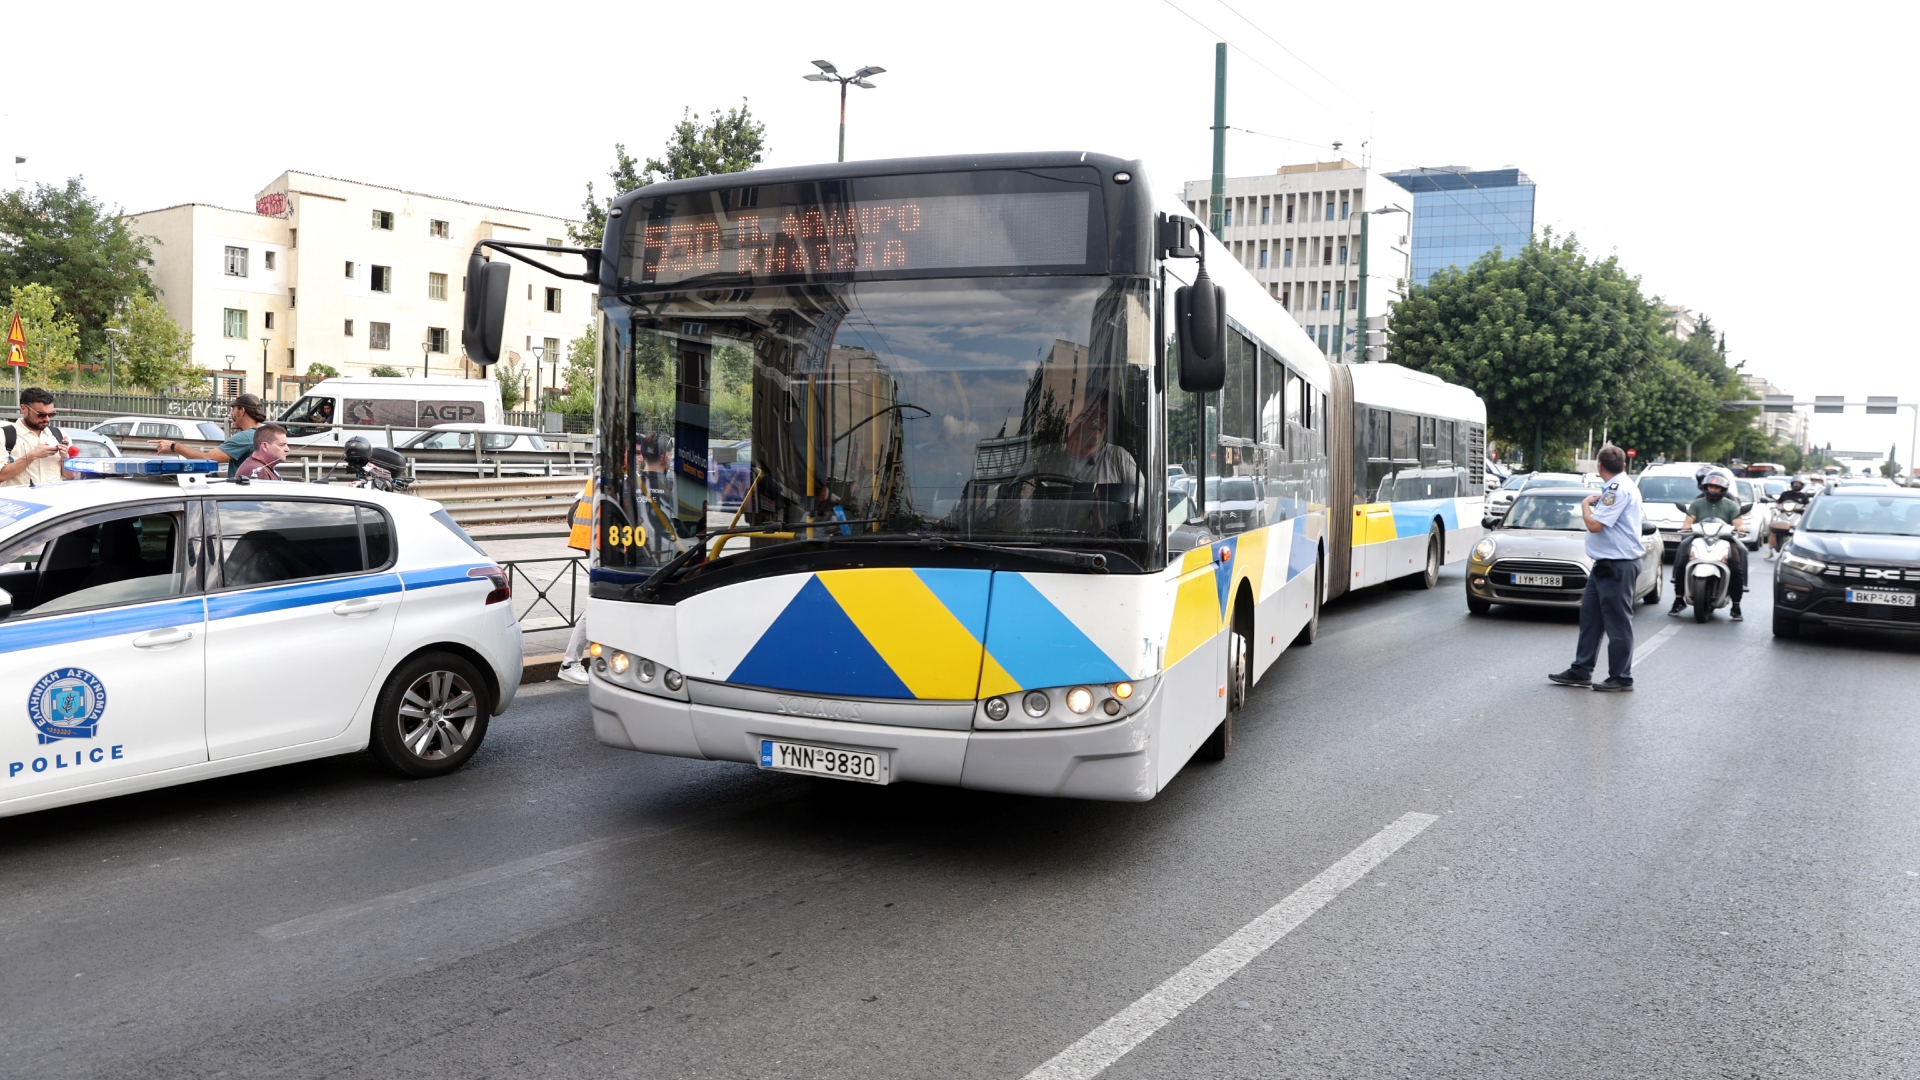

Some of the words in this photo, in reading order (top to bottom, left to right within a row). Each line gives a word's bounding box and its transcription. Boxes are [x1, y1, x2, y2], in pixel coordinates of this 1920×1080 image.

[645, 222, 720, 273] 550
[738, 240, 906, 275] ΚΗΦΙΣΙΑ
[421, 405, 475, 420] AGP
[608, 525, 647, 547] 830
[1855, 592, 1914, 605] BKP-4862
[30, 671, 60, 728] ΕΛΛΗΝΙΚΗ
[66, 668, 105, 720] ΑΣΤΥΝΟΜΙΑ
[776, 697, 862, 721] SOLARIS
[9, 744, 124, 778] POLICE
[779, 744, 876, 777] YNN-9830
